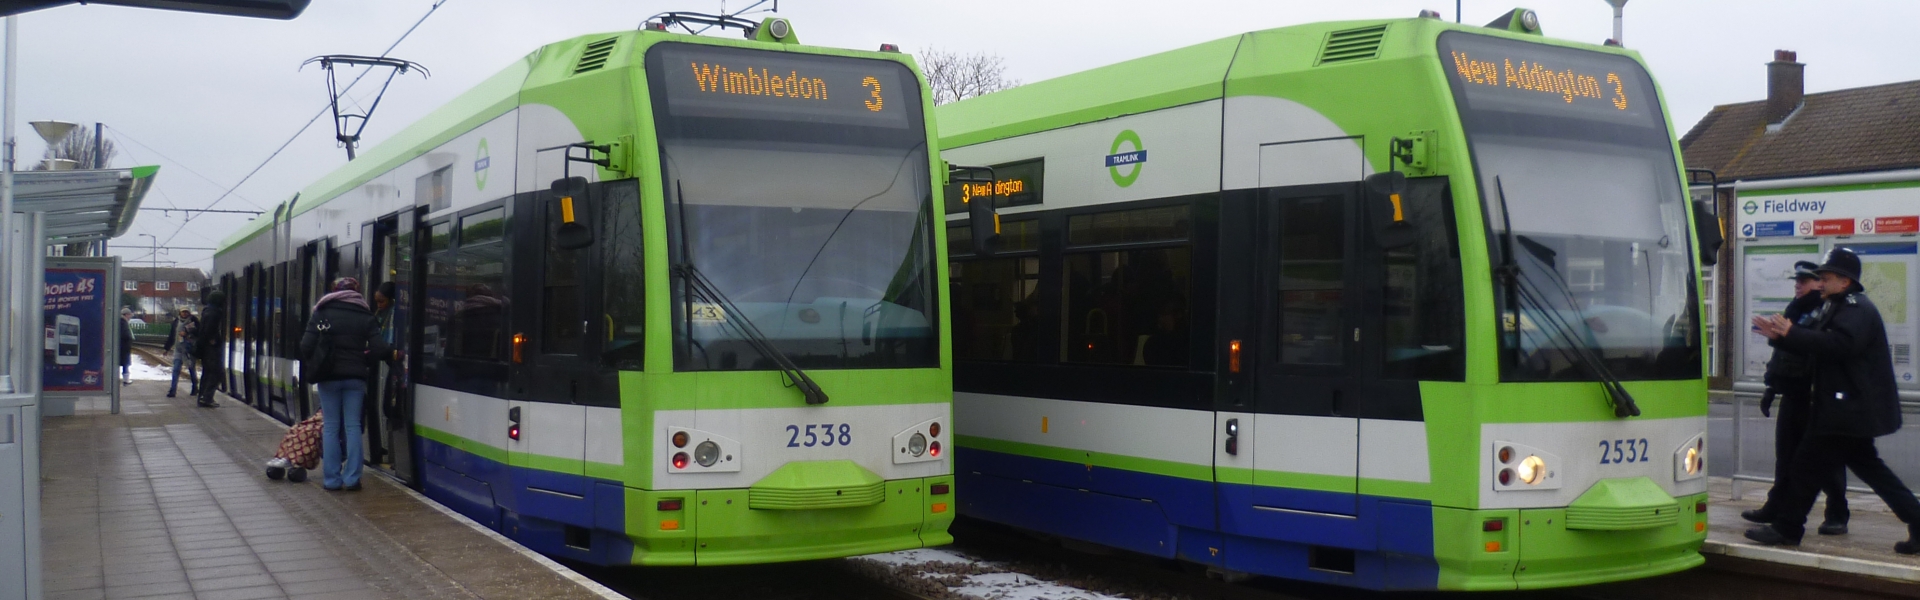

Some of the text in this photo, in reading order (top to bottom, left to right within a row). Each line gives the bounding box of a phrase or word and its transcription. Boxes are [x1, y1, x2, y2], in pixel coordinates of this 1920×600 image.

[691, 62, 883, 112] Wimbledon 3
[1451, 50, 1627, 110] New Addington 3
[1113, 153, 1139, 164] TRAMLINK
[962, 179, 1023, 203] 3 New Adington
[1764, 199, 1826, 215] Fieldway
[786, 423, 851, 448] 2538
[1599, 437, 1649, 465] 2532
